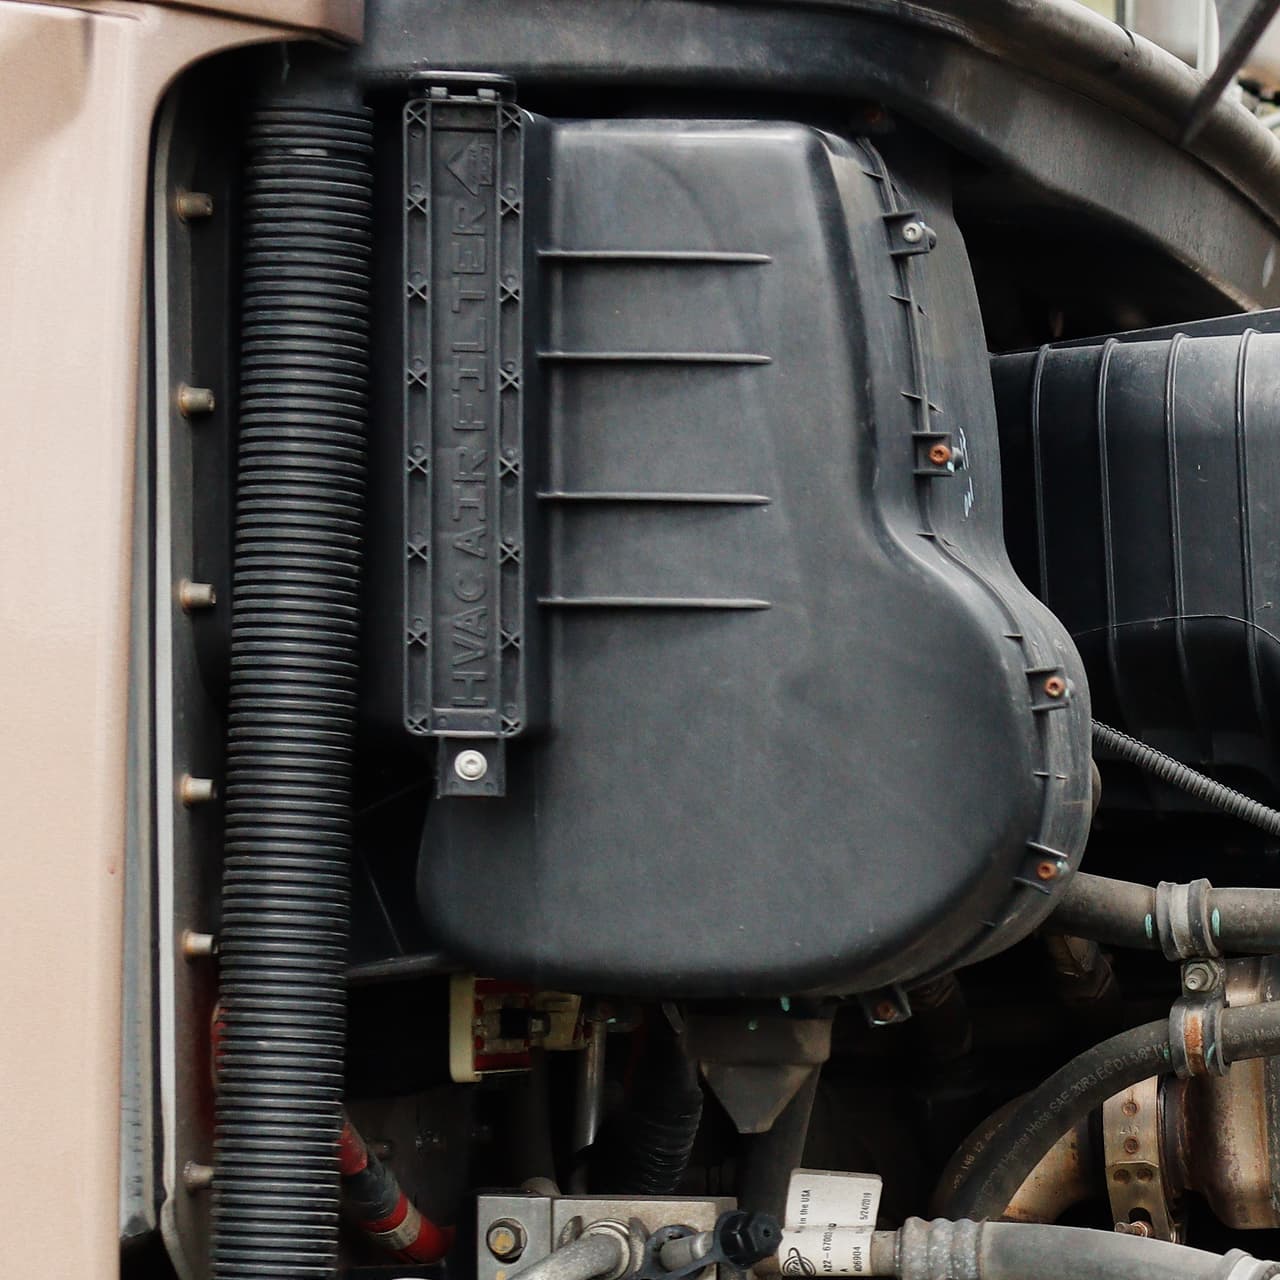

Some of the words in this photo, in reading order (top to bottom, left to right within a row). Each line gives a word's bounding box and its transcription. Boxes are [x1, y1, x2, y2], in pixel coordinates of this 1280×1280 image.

[450, 203, 488, 431] FILTER
[450, 446, 488, 559] AIR
[450, 572, 488, 708] HVAC
[801, 1189, 812, 1203] USA
